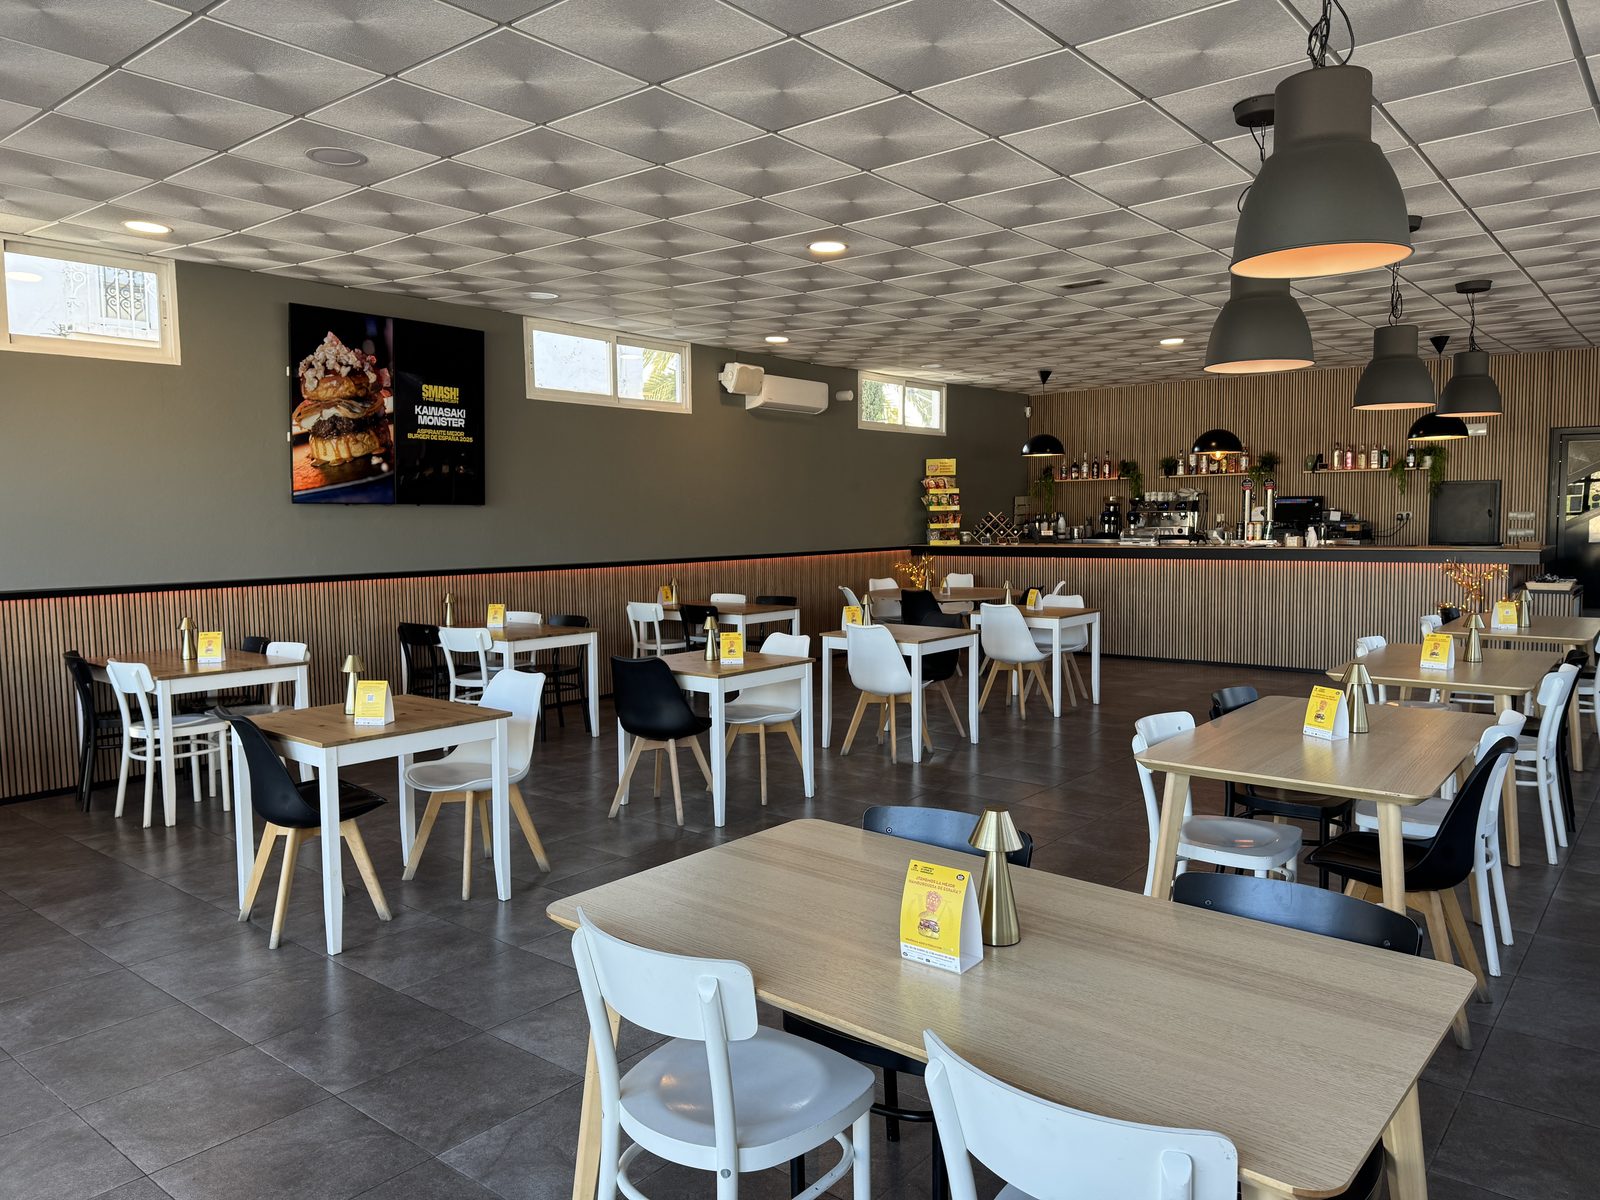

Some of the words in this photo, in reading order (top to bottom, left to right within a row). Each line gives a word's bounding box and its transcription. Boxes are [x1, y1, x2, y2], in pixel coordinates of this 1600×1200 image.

[421, 384, 460, 401] SMASH!
[414, 405, 466, 418] KAWASAKI
[418, 415, 465, 428] MONSTER
